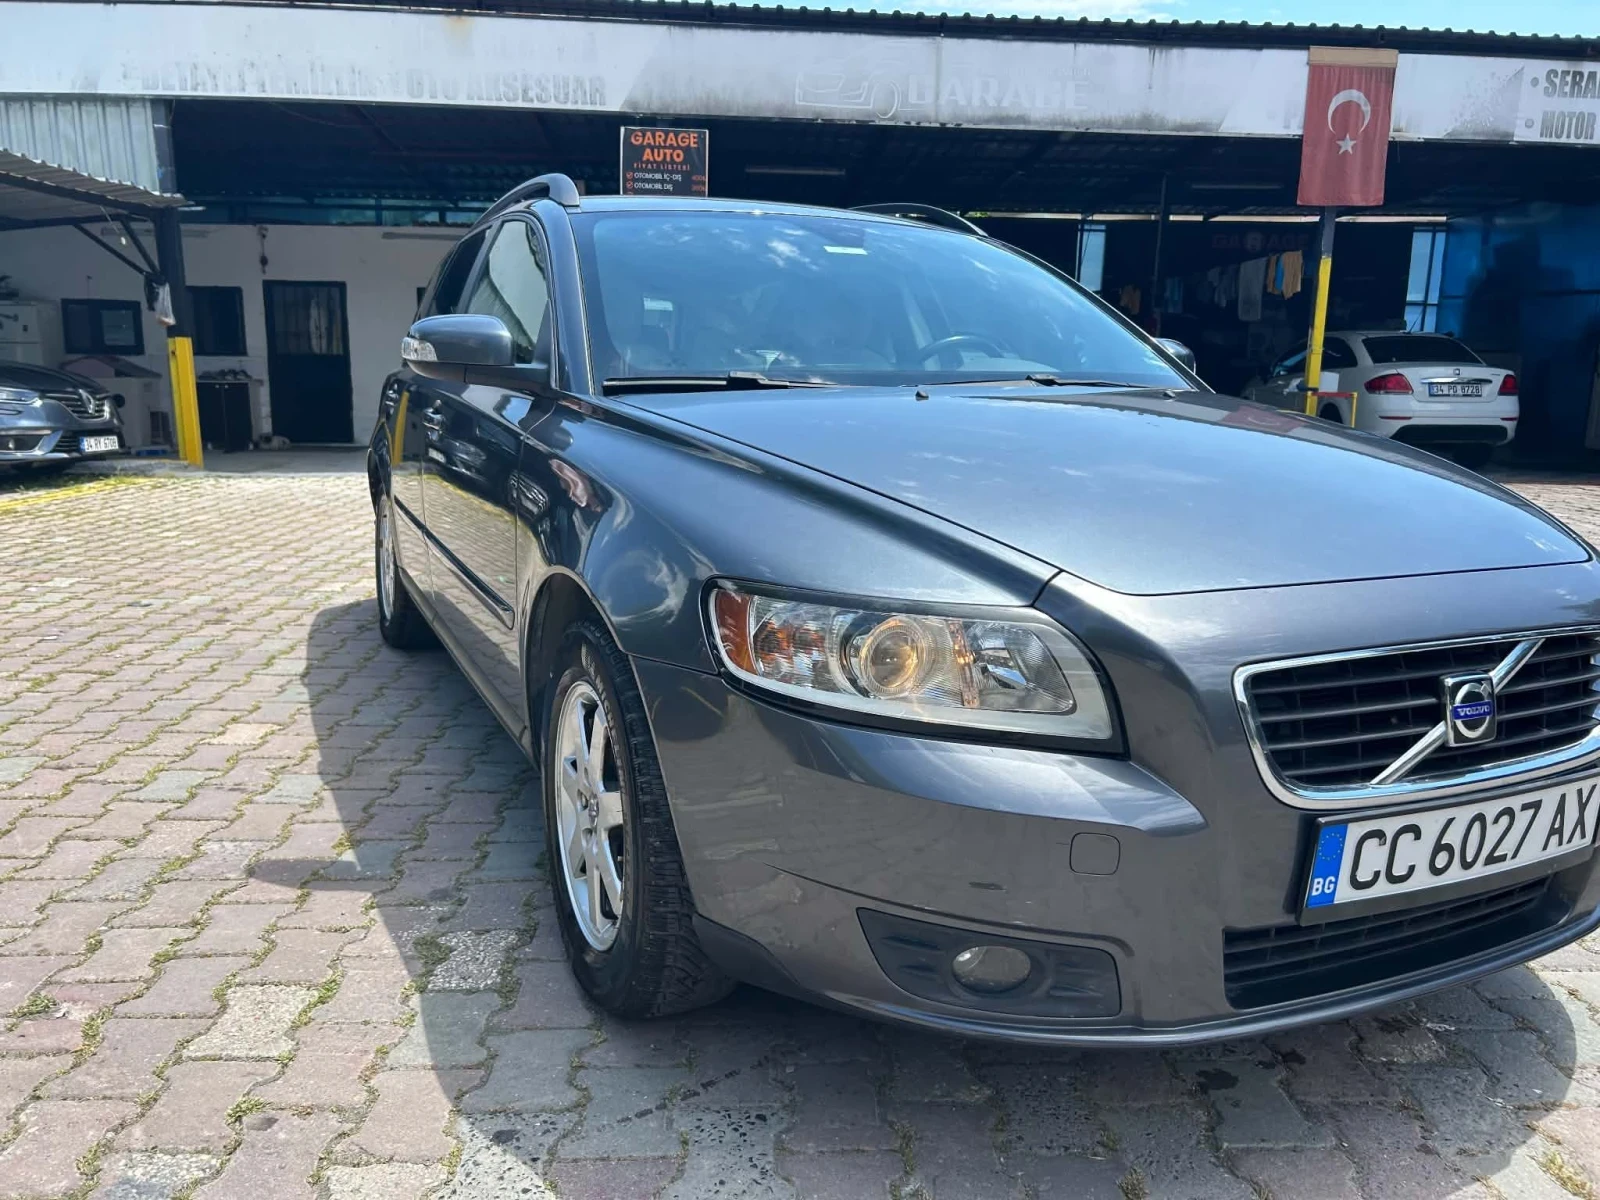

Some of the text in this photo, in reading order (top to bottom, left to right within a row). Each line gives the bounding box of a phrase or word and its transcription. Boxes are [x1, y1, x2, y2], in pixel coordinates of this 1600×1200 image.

[1543, 69, 1600, 100] SERA
[1539, 110, 1597, 140] MOTOR
[630, 131, 699, 148] GARAGE
[642, 148, 685, 163] AUTO
[1457, 704, 1490, 716] VOLVO
[1311, 783, 1597, 896] BG CC 6027 AX
